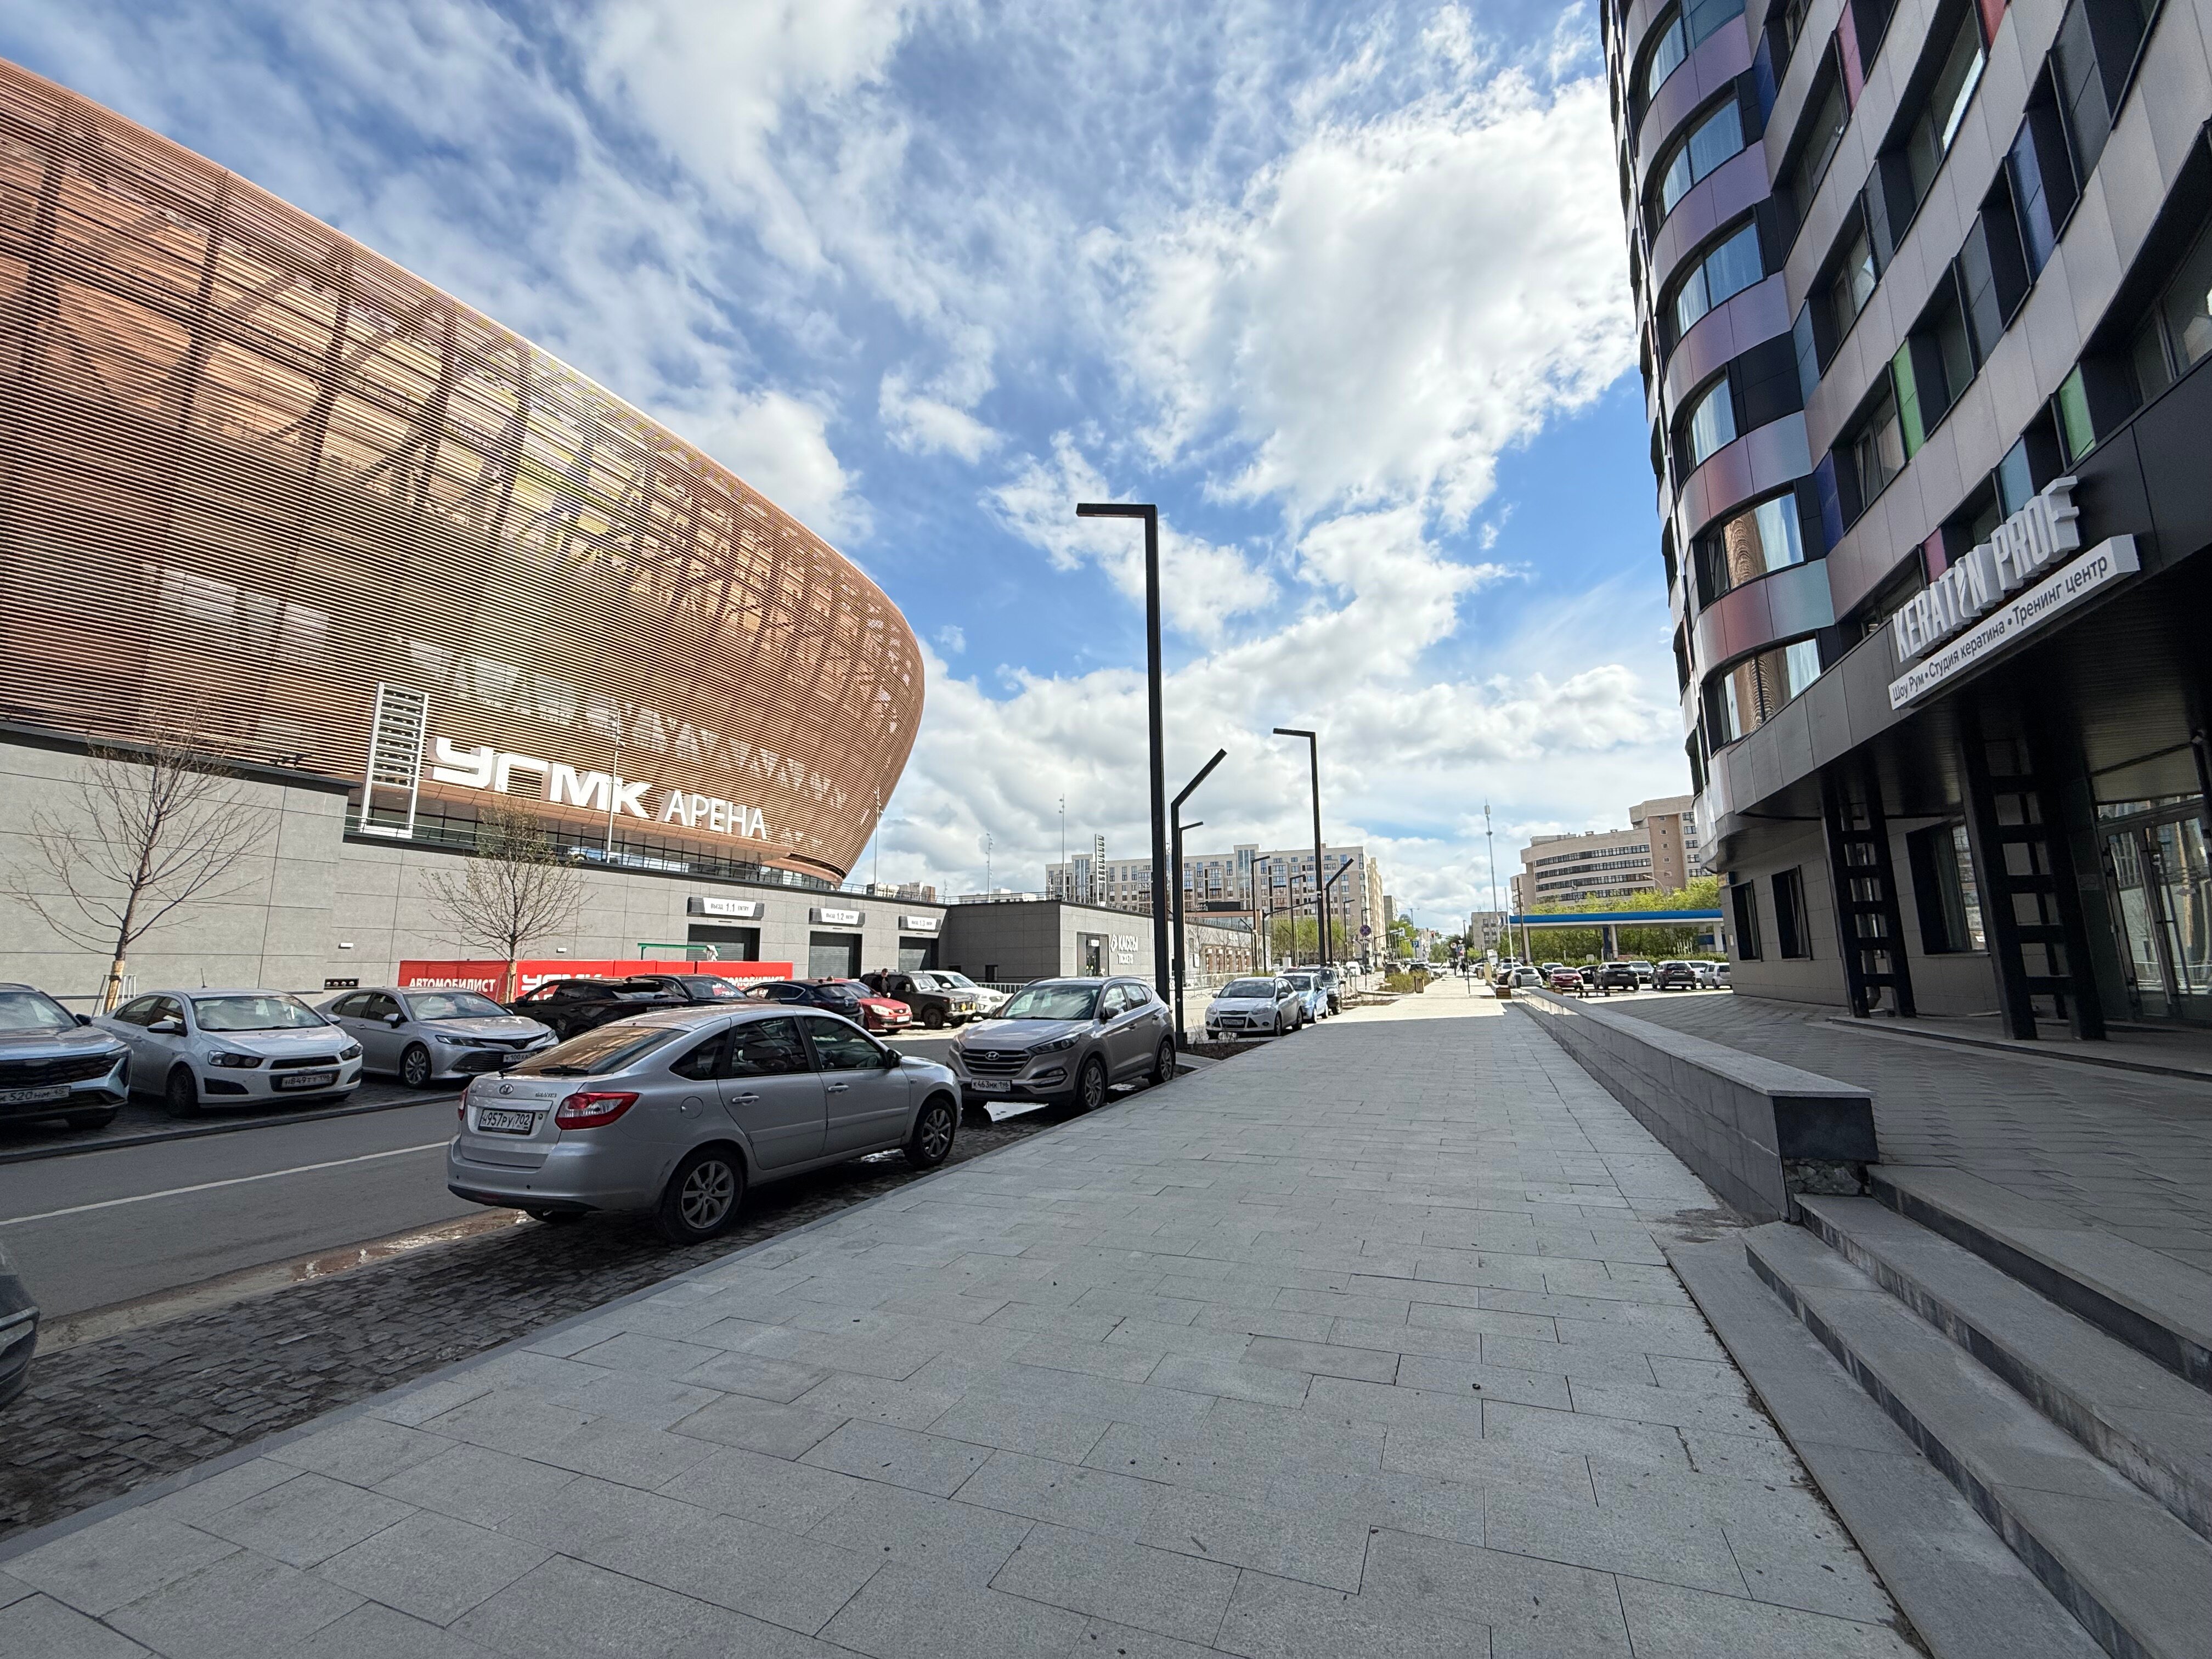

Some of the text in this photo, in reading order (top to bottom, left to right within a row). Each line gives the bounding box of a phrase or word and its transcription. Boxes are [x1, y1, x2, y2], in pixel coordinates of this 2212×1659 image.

[1893, 476, 2080, 662] KERATIN PROF
[1893, 555, 2108, 701] Шоу Рум Студия кератина Тренинг центр
[425, 736, 768, 840] УГМК АРЕНА
[726, 902, 735, 912] 1.1
[1118, 934, 1138, 951] КАССЫ
[409, 978, 496, 992] АВТОМОБИЛИСТ
[515, 1114, 530, 1125] 702
